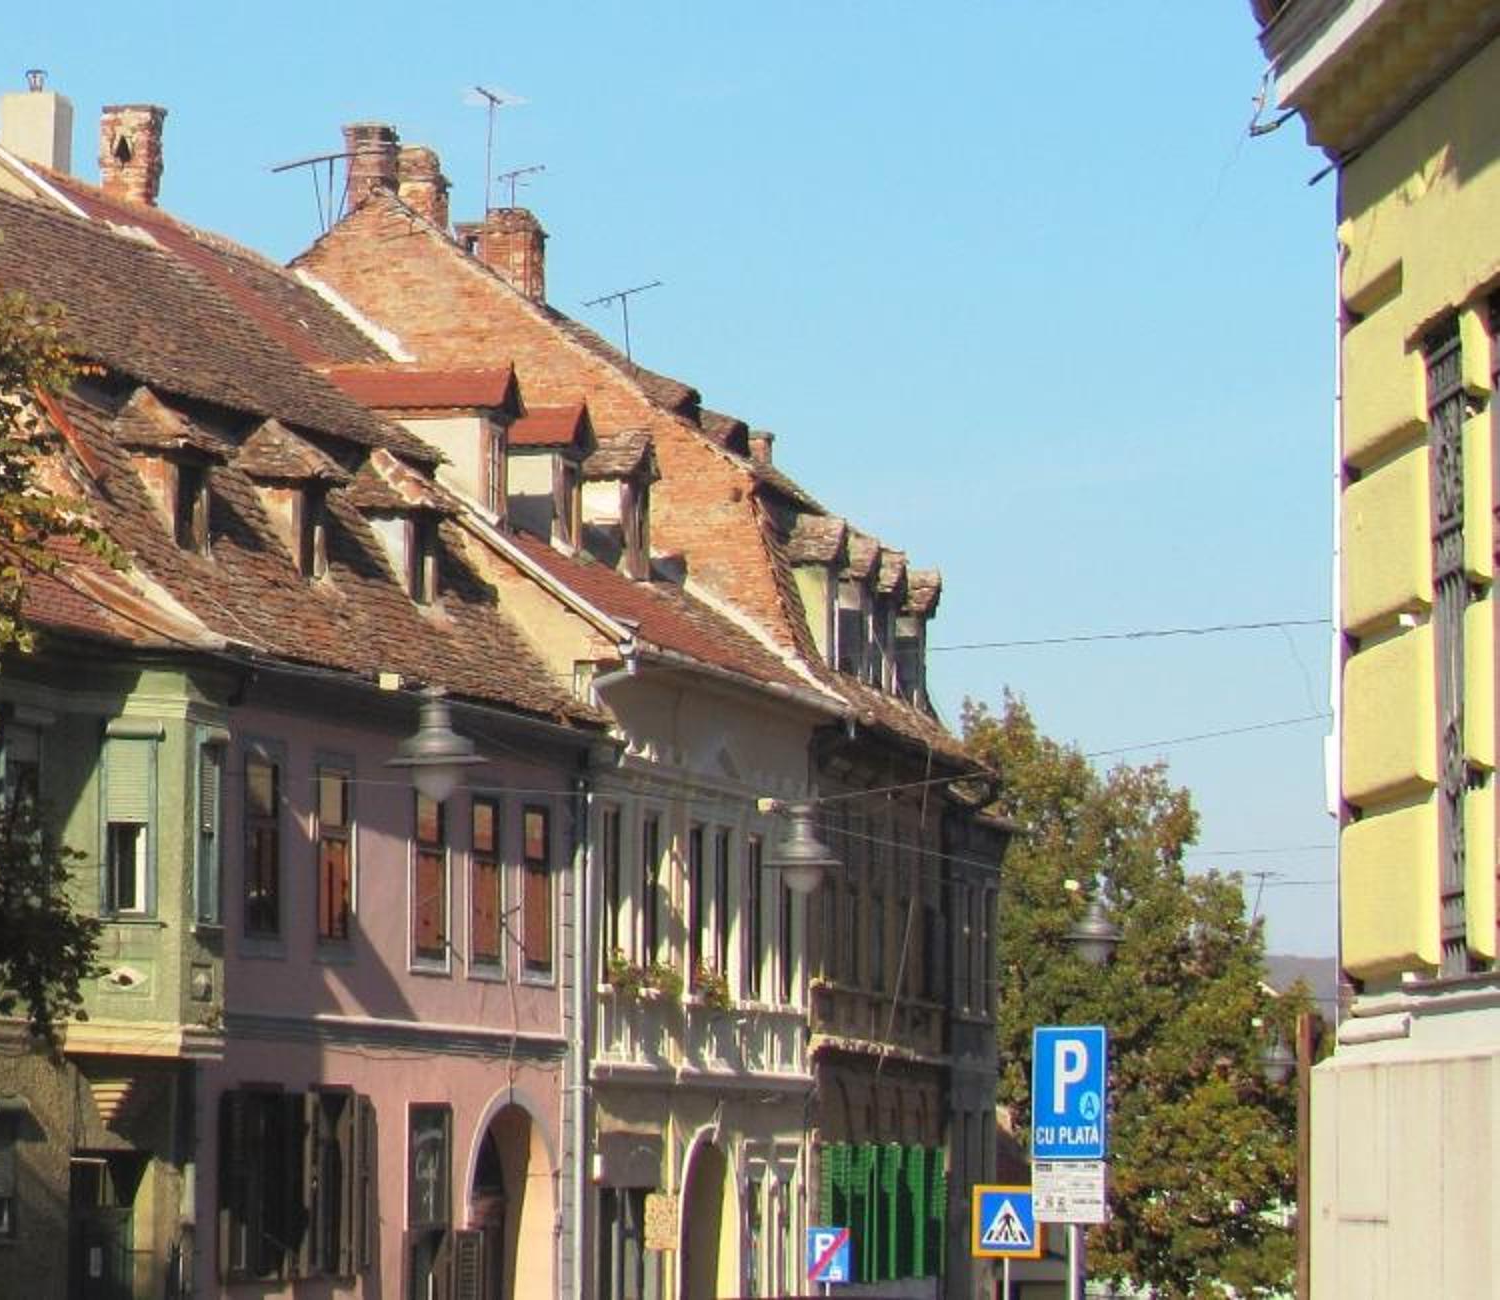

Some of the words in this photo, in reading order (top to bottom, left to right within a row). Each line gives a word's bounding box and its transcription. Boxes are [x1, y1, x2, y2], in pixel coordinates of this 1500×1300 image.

[1053, 1039, 1088, 1115] P
[1083, 1095, 1096, 1115] A
[1035, 1126, 1055, 1145] CU
